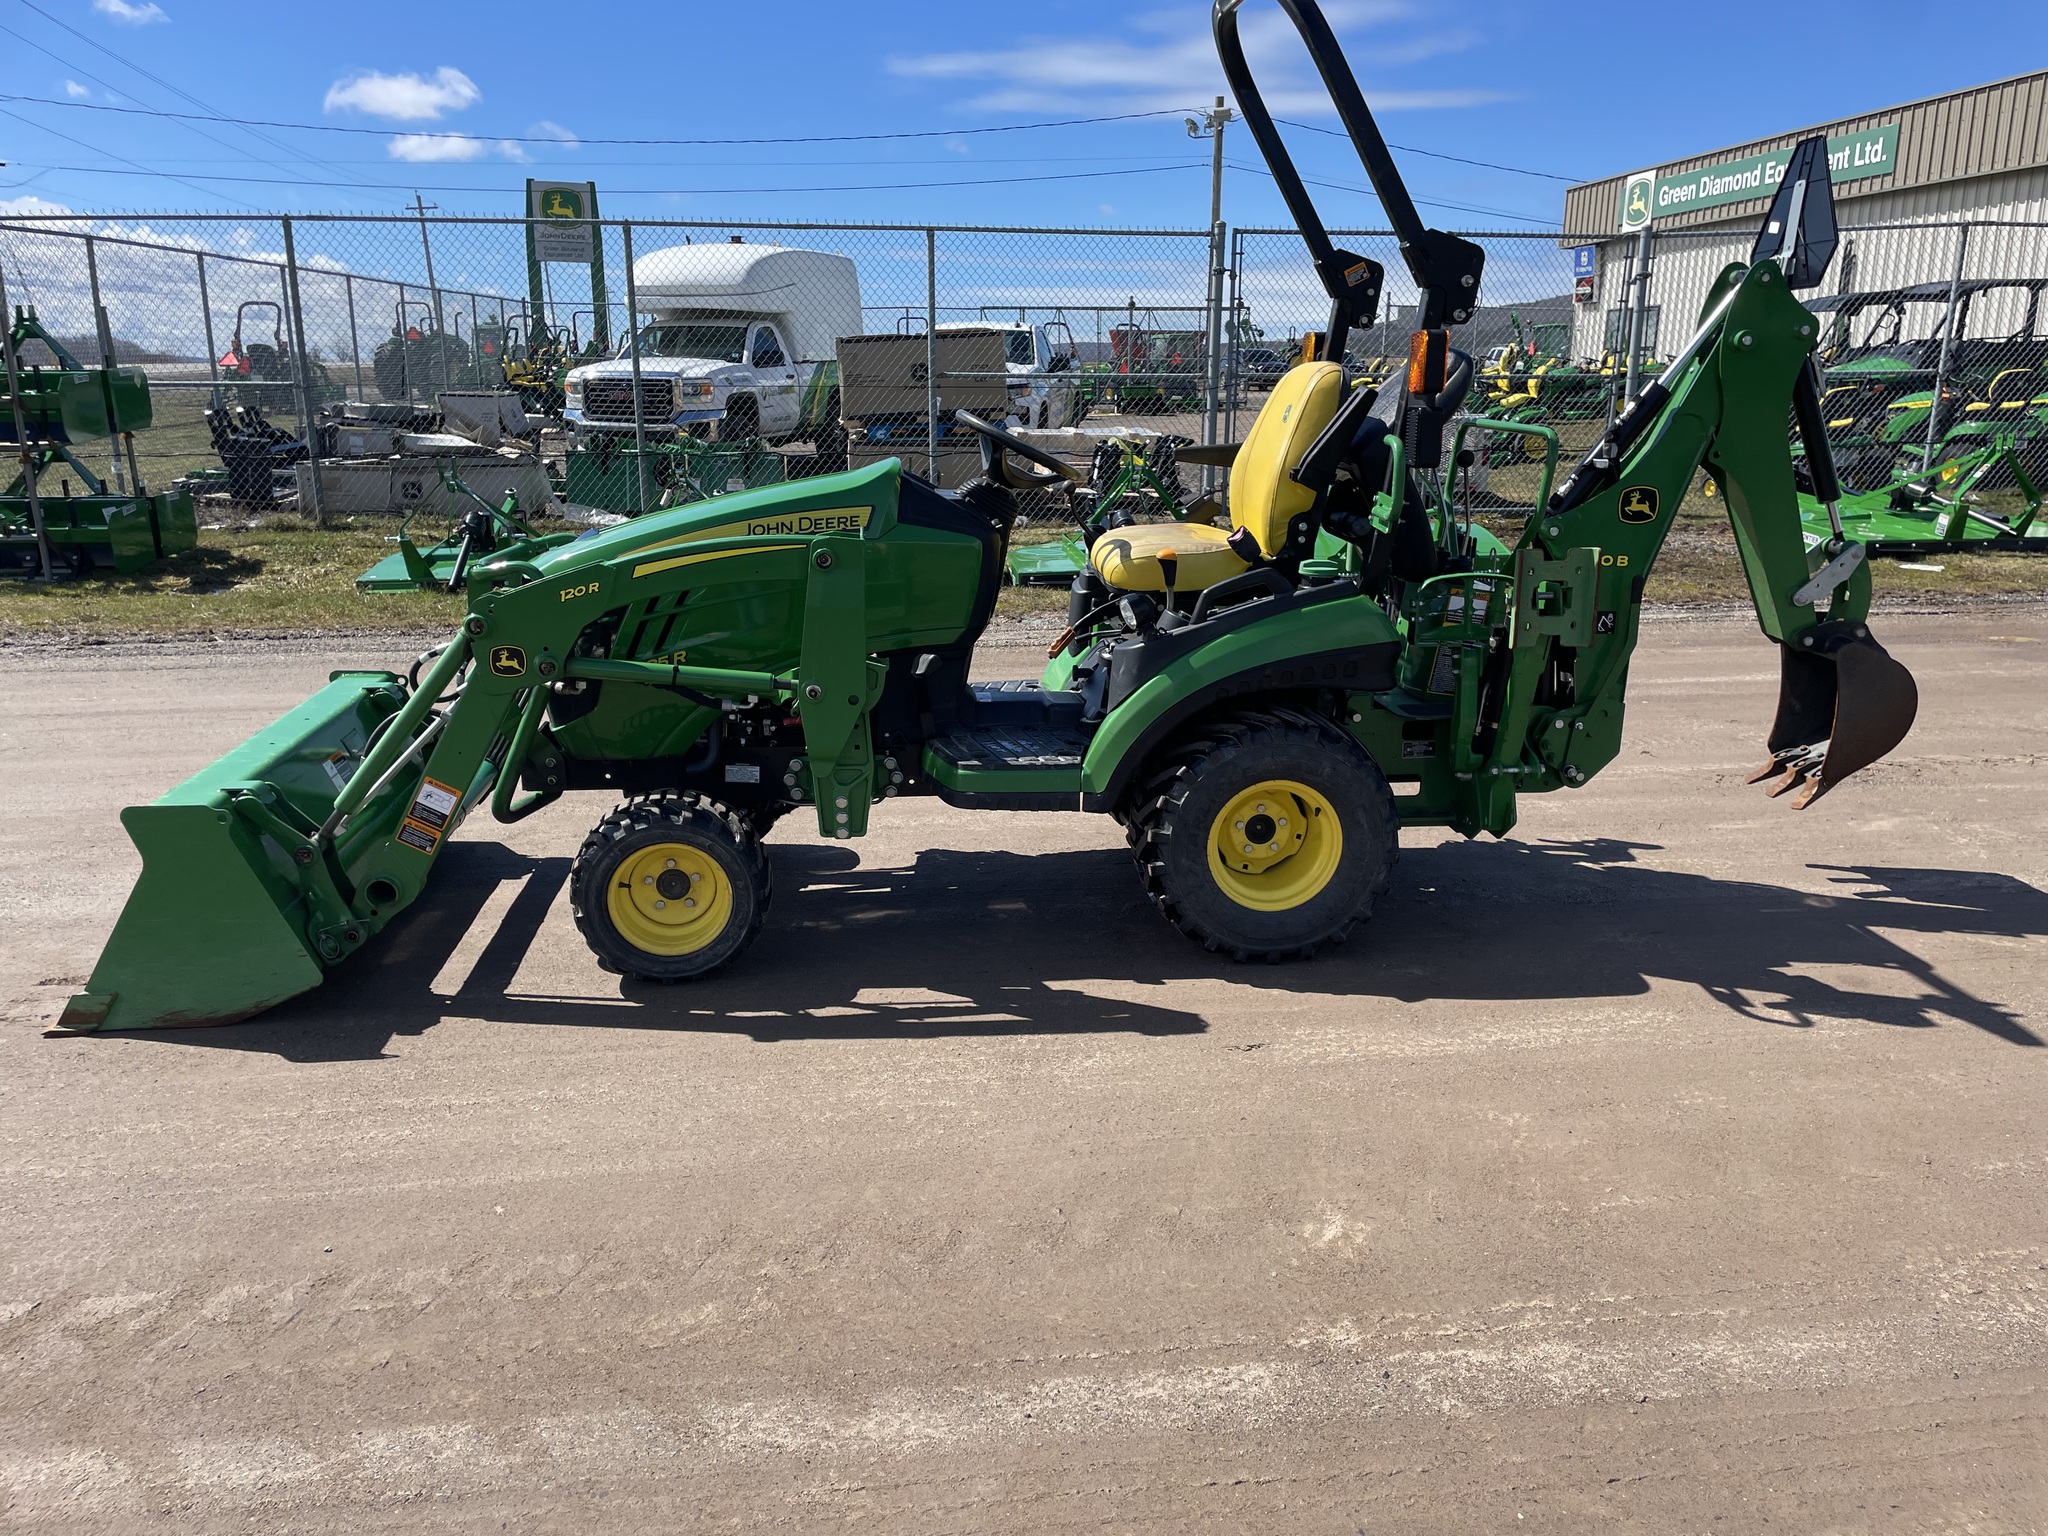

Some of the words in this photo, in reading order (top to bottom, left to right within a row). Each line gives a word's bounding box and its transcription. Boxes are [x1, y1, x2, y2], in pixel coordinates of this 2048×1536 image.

[1658, 185, 1696, 207] Green
[1699, 163, 1761, 198] Diamond
[1853, 137, 1887, 167] Ltd.
[746, 520, 794, 536] JOHN
[798, 515, 861, 532] DEERE
